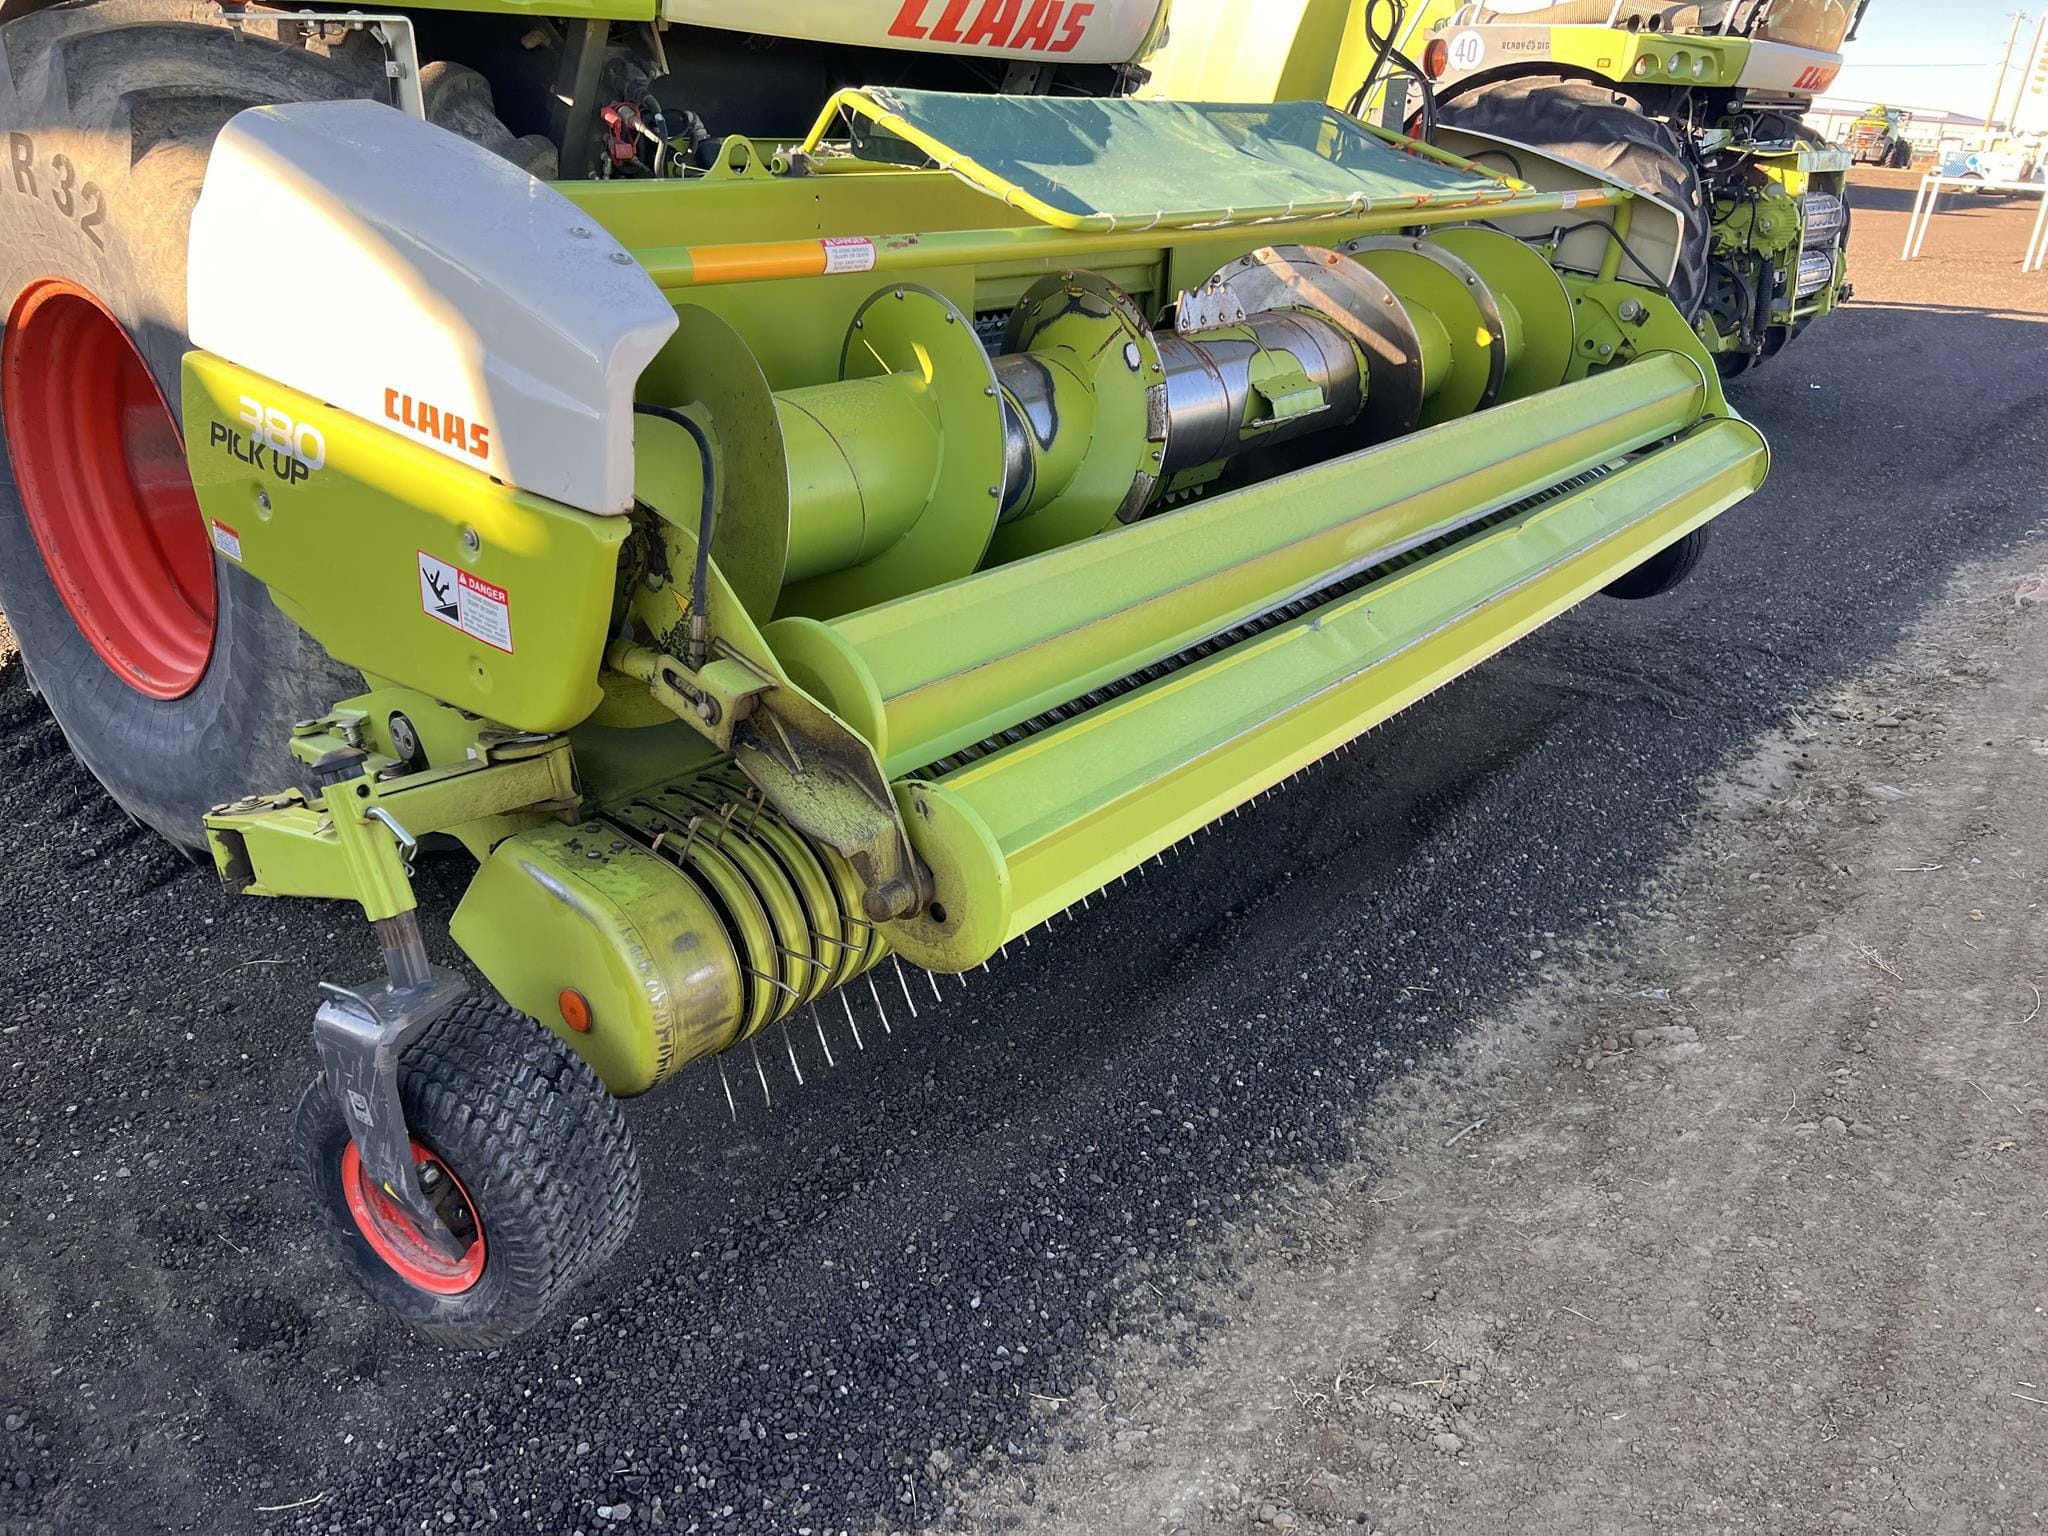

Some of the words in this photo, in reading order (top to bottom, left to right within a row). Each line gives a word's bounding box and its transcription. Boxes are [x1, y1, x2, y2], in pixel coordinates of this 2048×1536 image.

[1455, 39, 1477, 62] 40
[1502, 41, 1526, 50] READY
[10, 131, 41, 200] R
[52, 153, 107, 253] 32
[210, 421, 265, 470] PICK
[272, 447, 309, 485] UP
[239, 395, 326, 471] 380
[385, 388, 489, 459] CLAAS
[469, 578, 506, 603] DANGER
